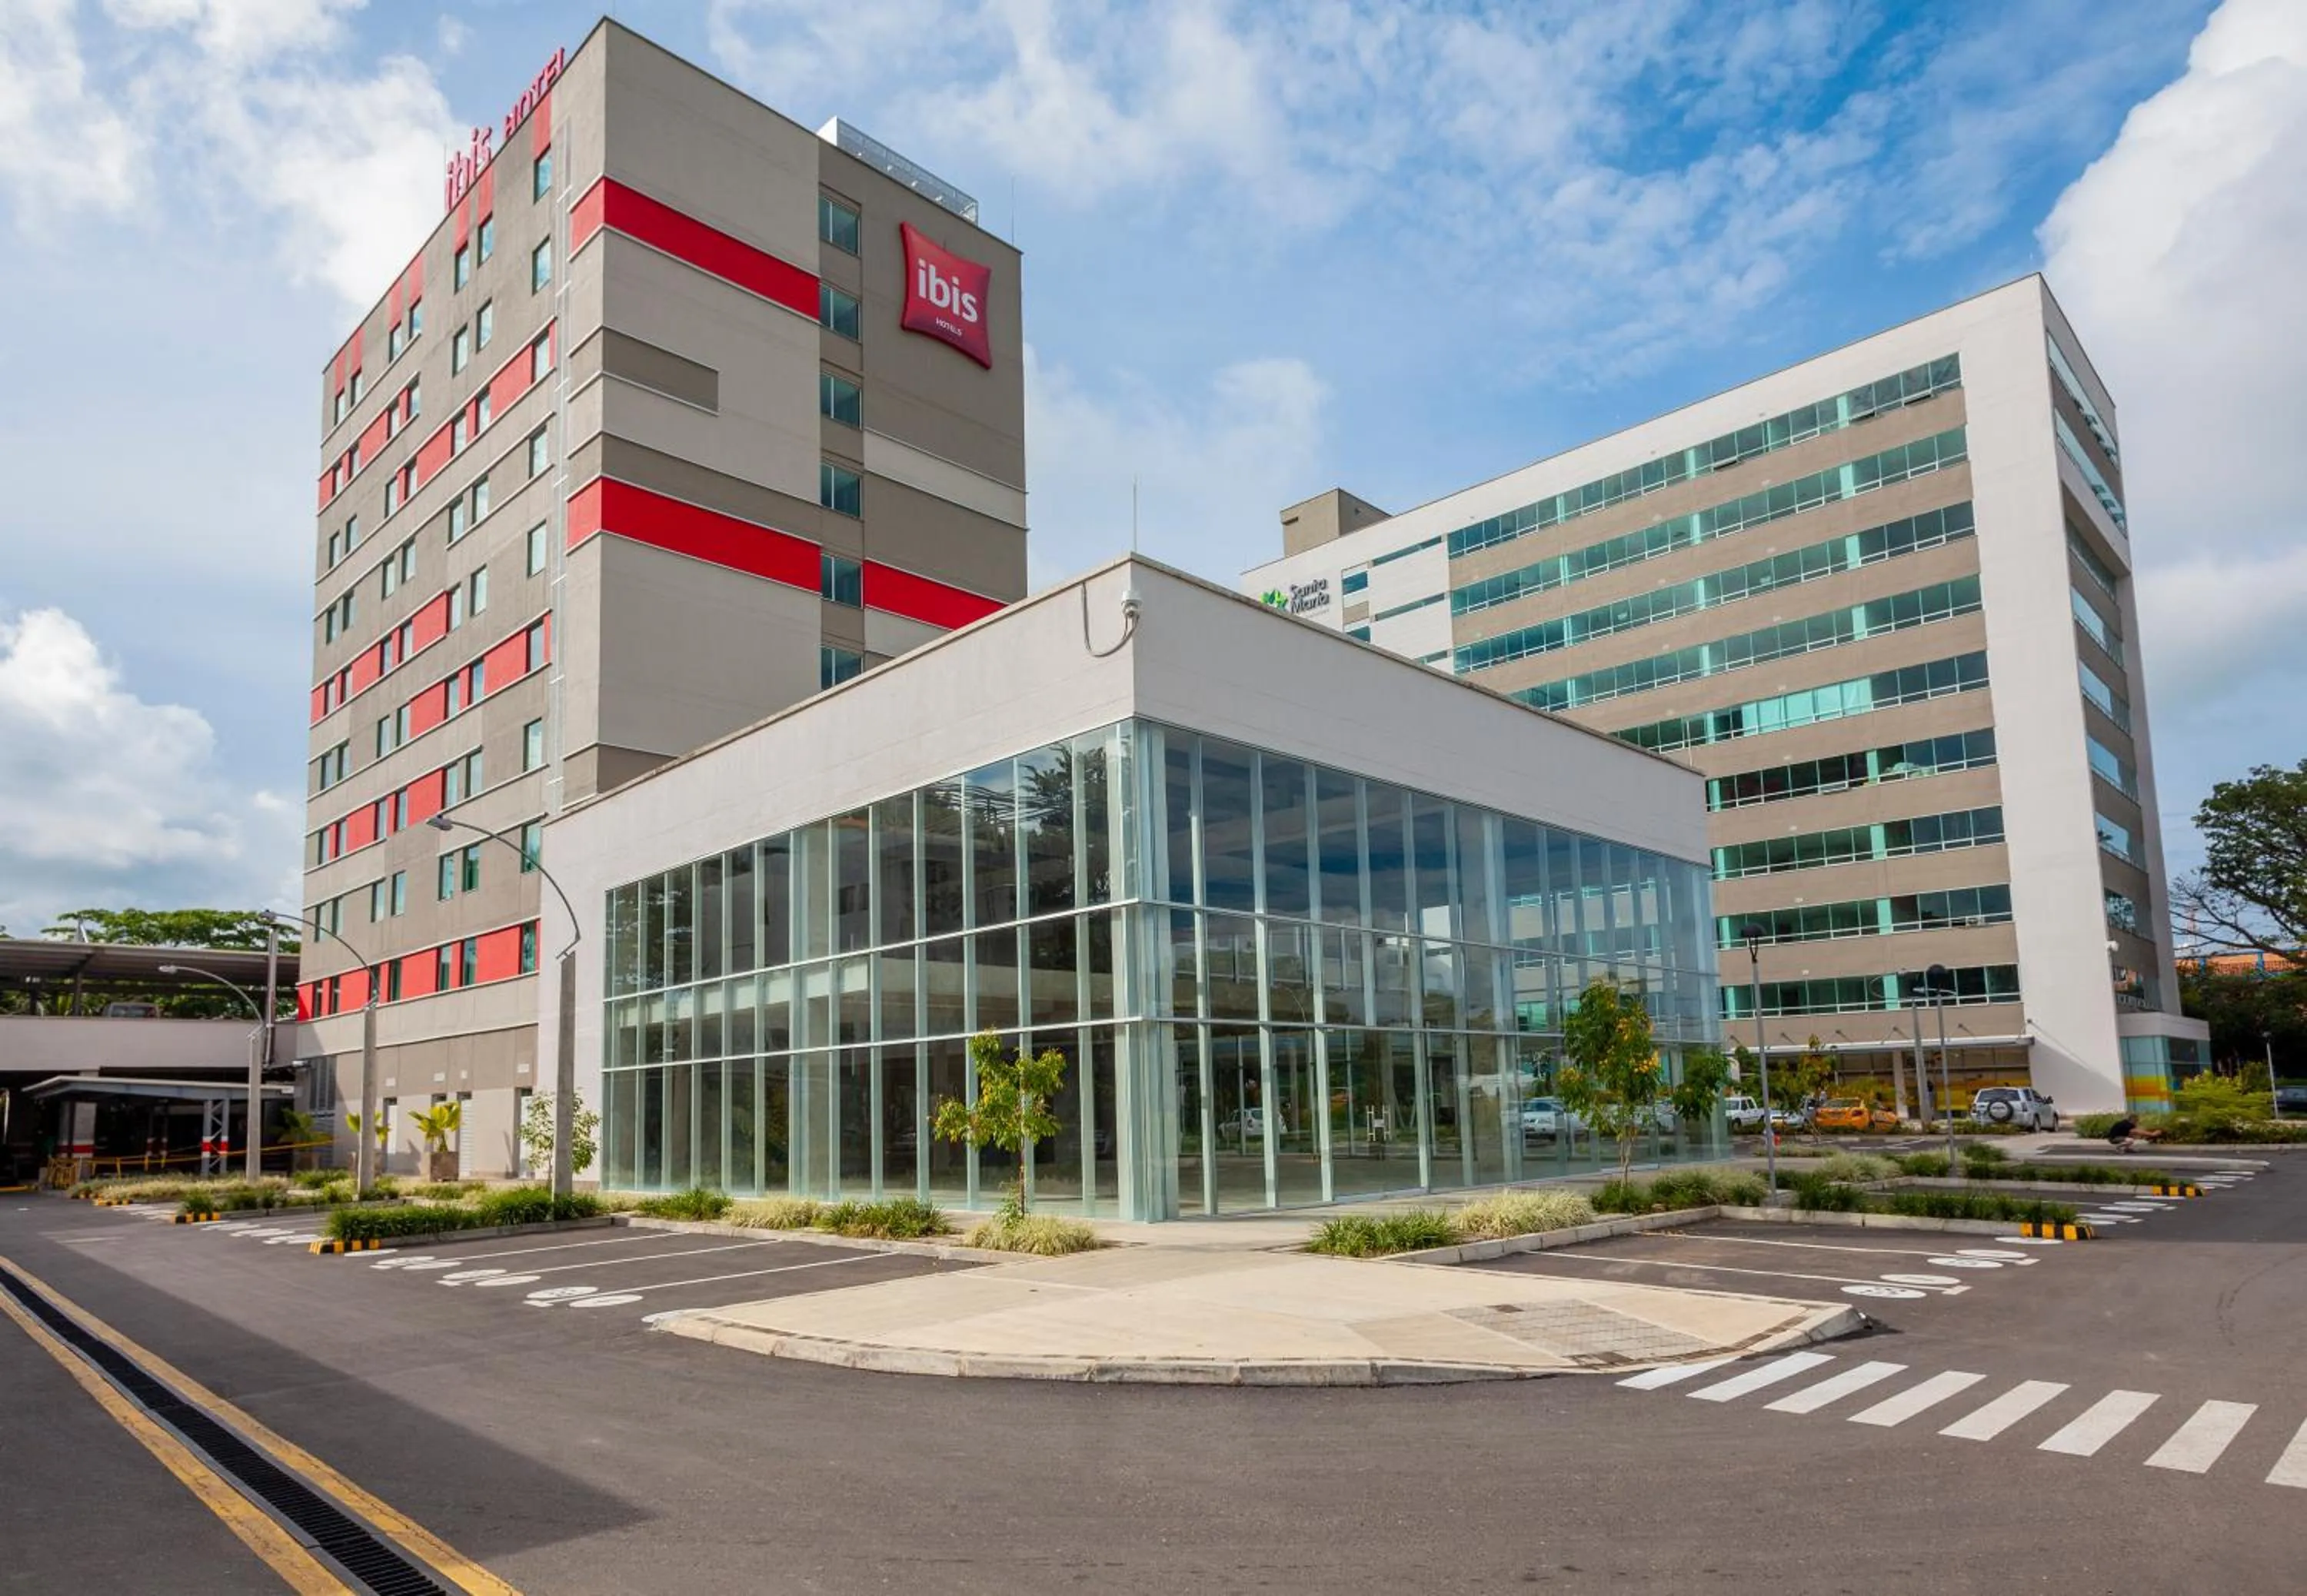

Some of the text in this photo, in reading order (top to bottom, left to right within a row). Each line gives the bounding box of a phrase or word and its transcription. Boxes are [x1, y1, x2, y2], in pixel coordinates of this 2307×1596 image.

[444, 127, 493, 211] ibis
[917, 258, 978, 322] ibis
[935, 316, 963, 336] HOTELS
[1290, 578, 1327, 600] Santa
